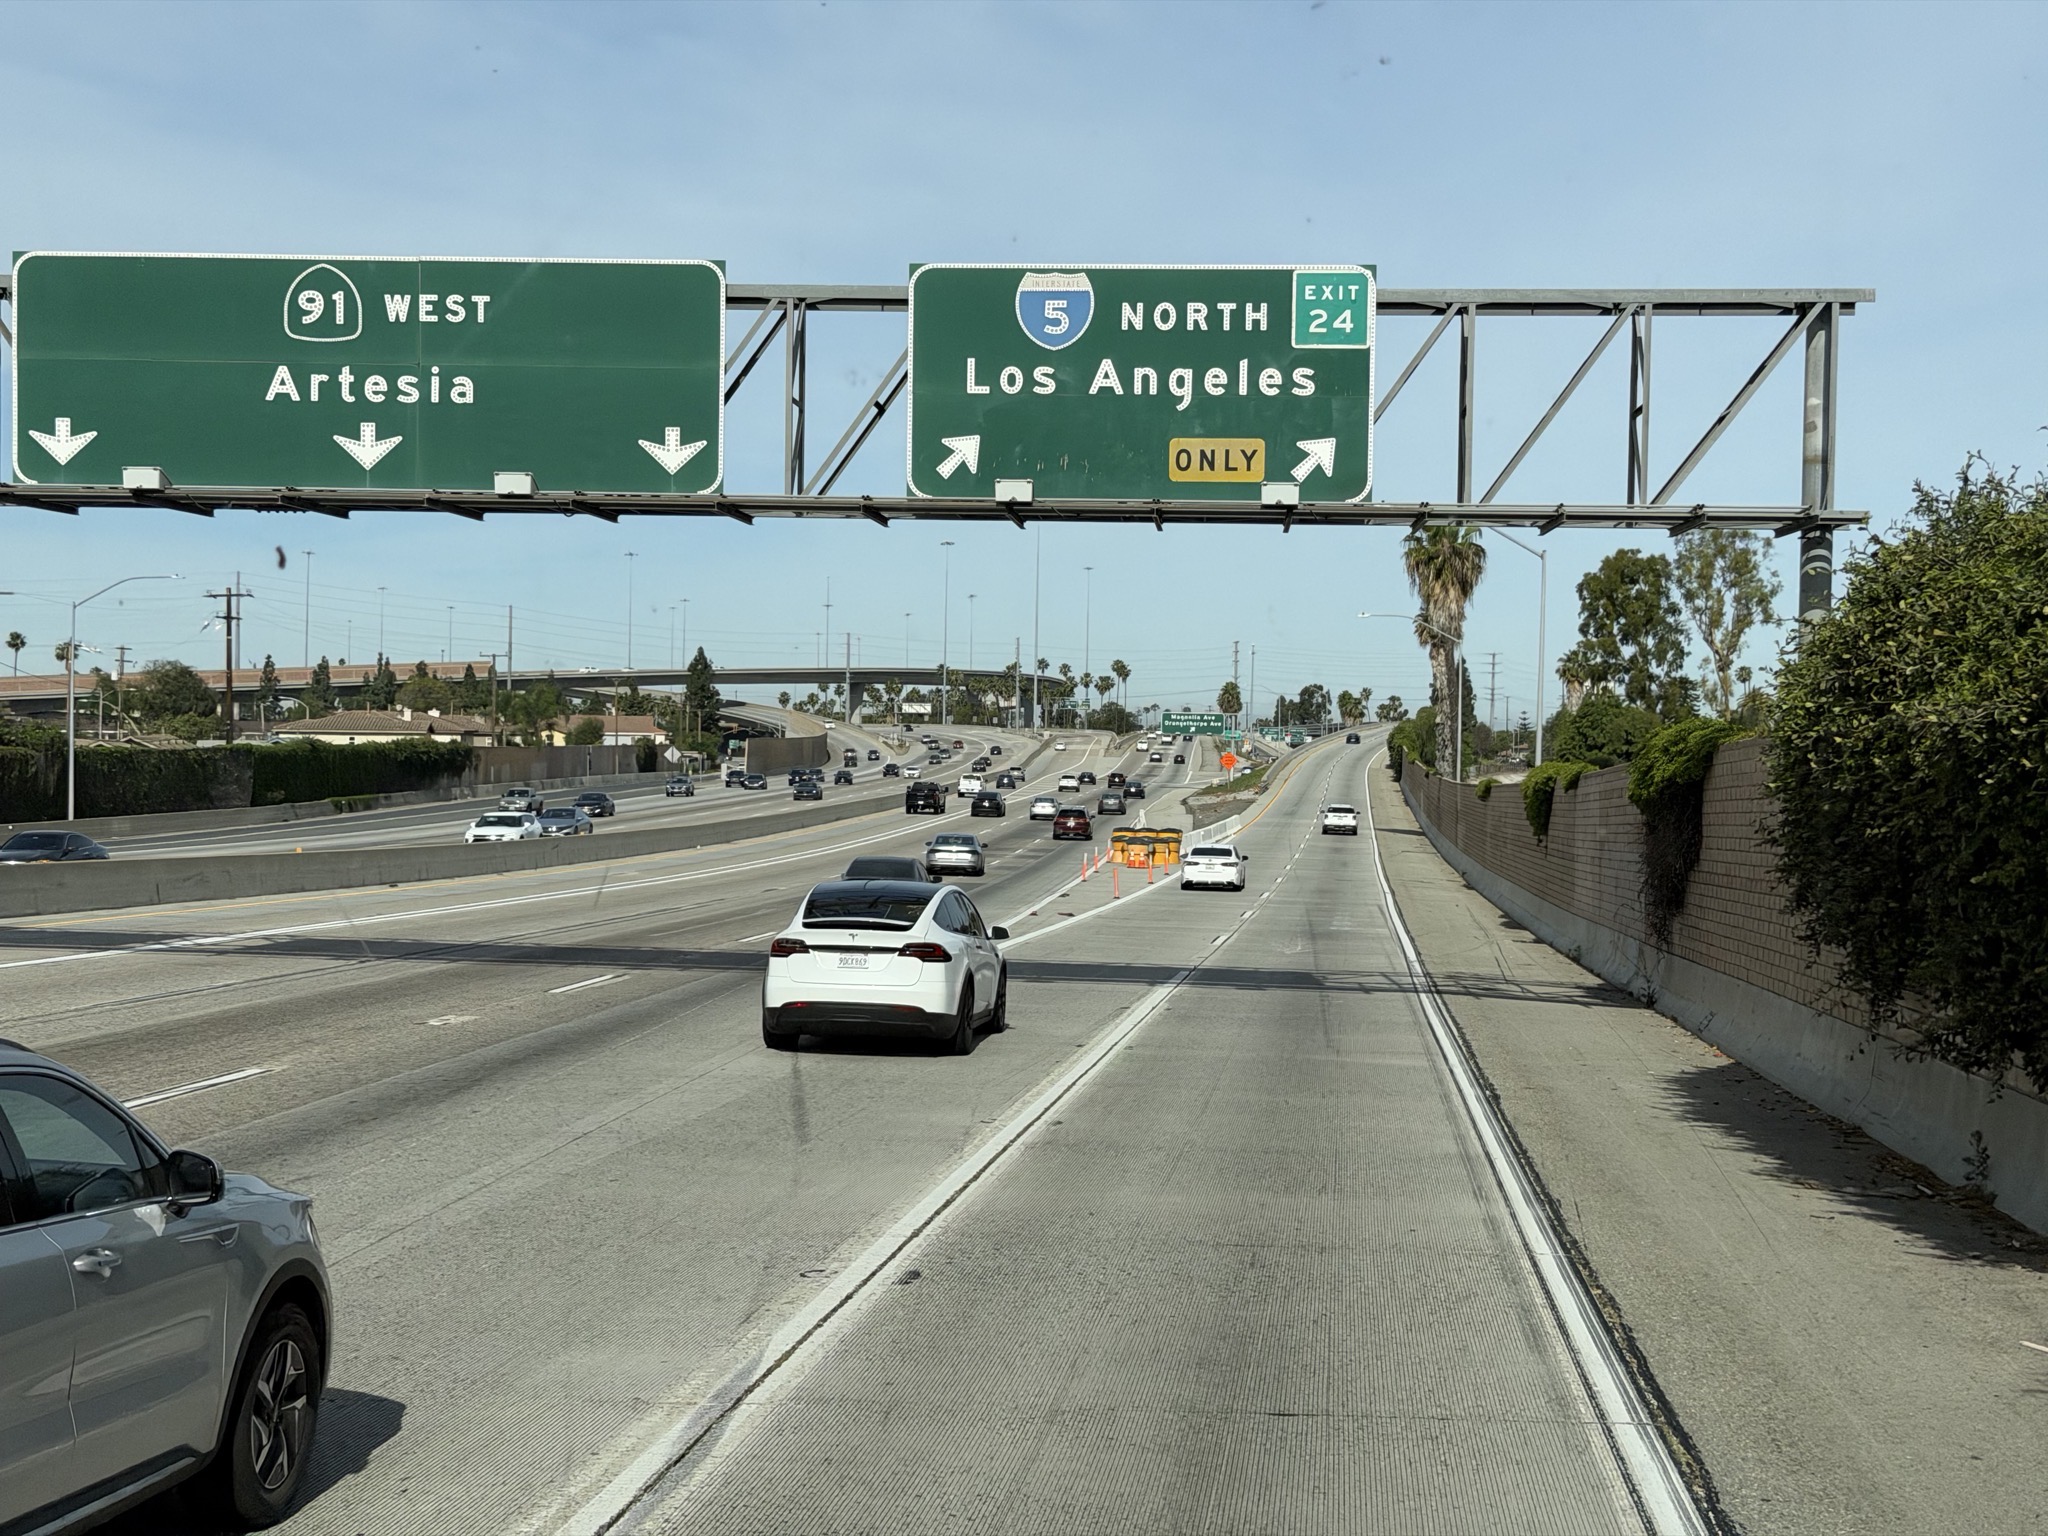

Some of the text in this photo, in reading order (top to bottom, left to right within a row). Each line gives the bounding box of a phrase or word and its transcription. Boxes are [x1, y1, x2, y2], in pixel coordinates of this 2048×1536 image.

[1031, 279, 1082, 288] INTERSTATE
[1304, 285, 1359, 301] EXIT
[297, 290, 490, 325] 91 WEST
[1044, 300, 1268, 335] 5 NORTH
[1309, 309, 1354, 333] 24
[265, 365, 474, 404] Artesia
[966, 358, 1316, 411] Los Angeles
[1175, 448, 1258, 472] ONLY
